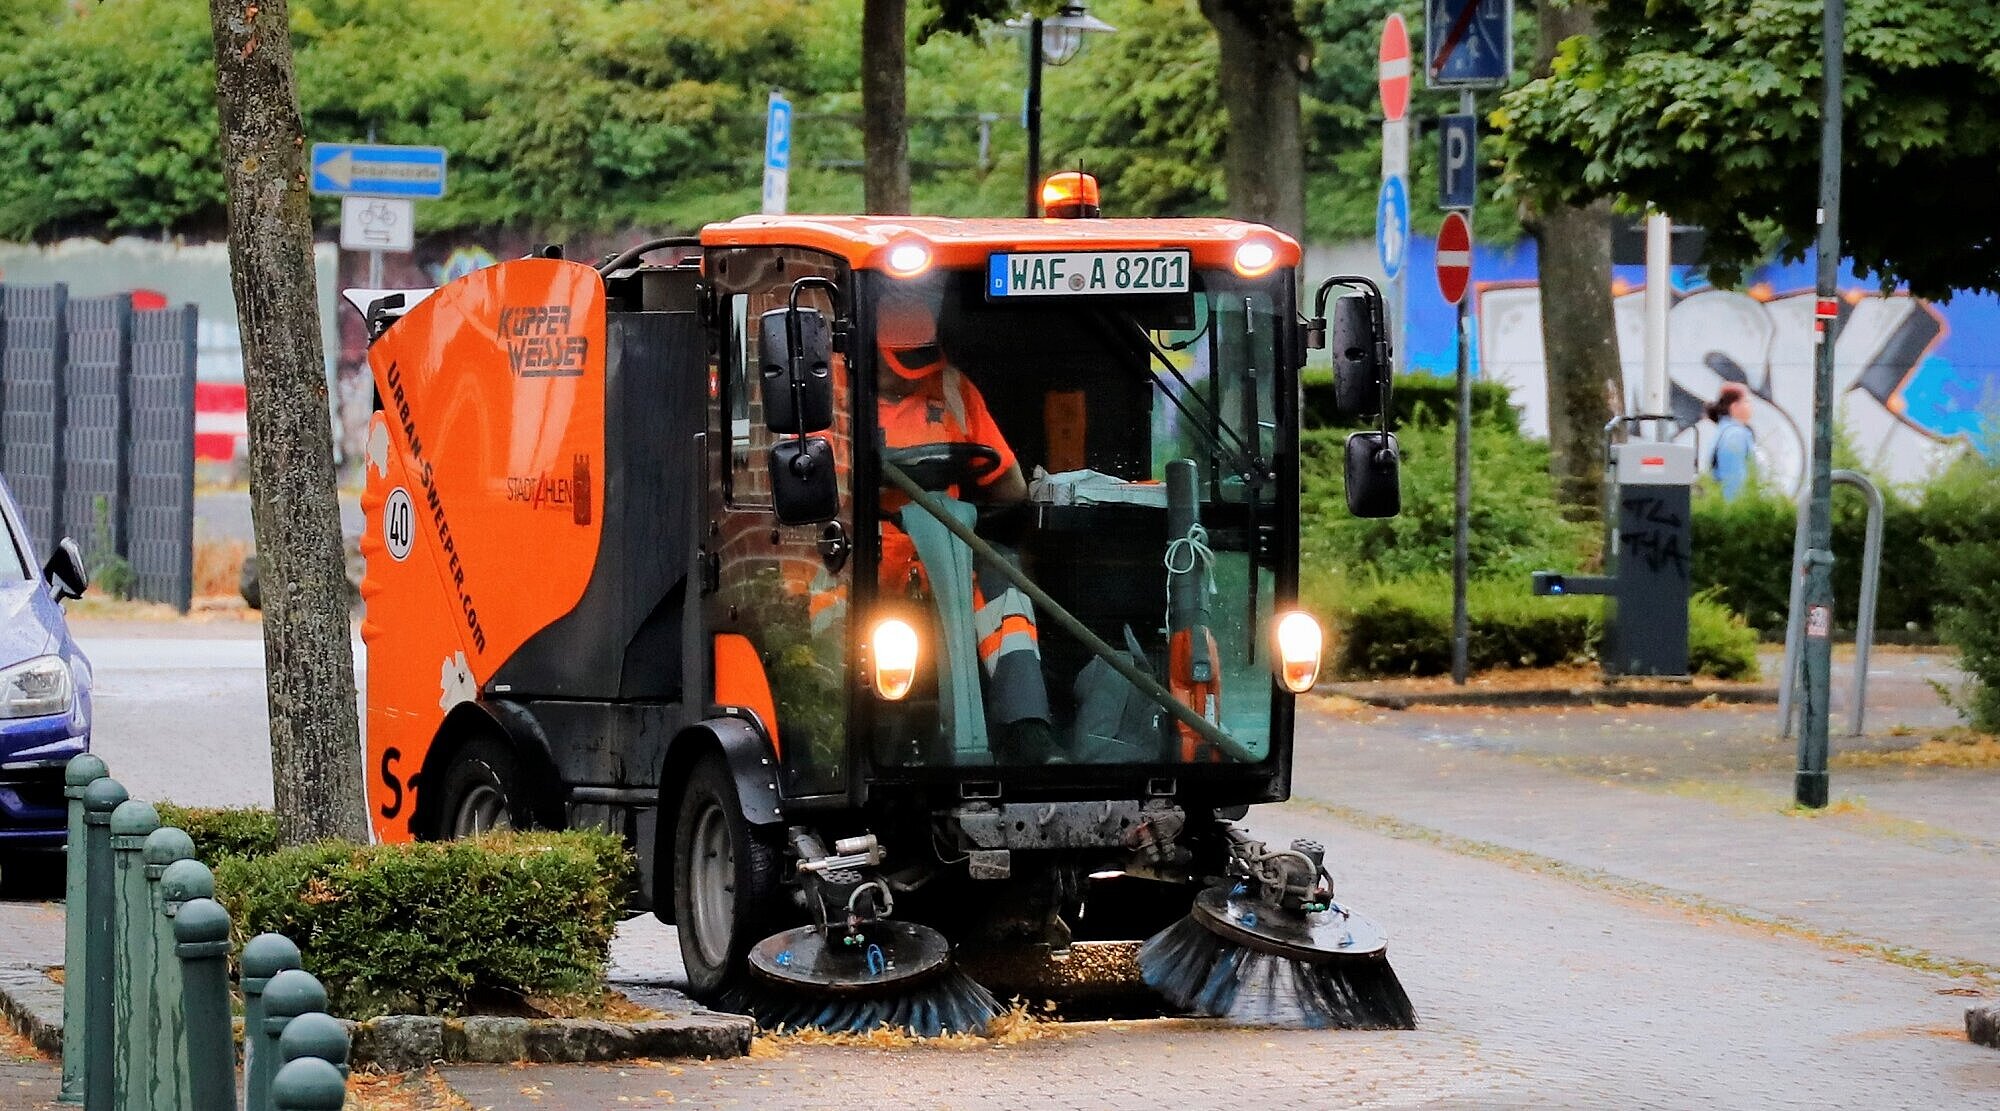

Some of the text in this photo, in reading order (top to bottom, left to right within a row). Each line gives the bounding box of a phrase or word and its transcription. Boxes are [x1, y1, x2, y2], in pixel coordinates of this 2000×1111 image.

[1447, 127, 1467, 195] P
[995, 256, 1185, 290] D WAF A 8201
[390, 501, 409, 547] 40
